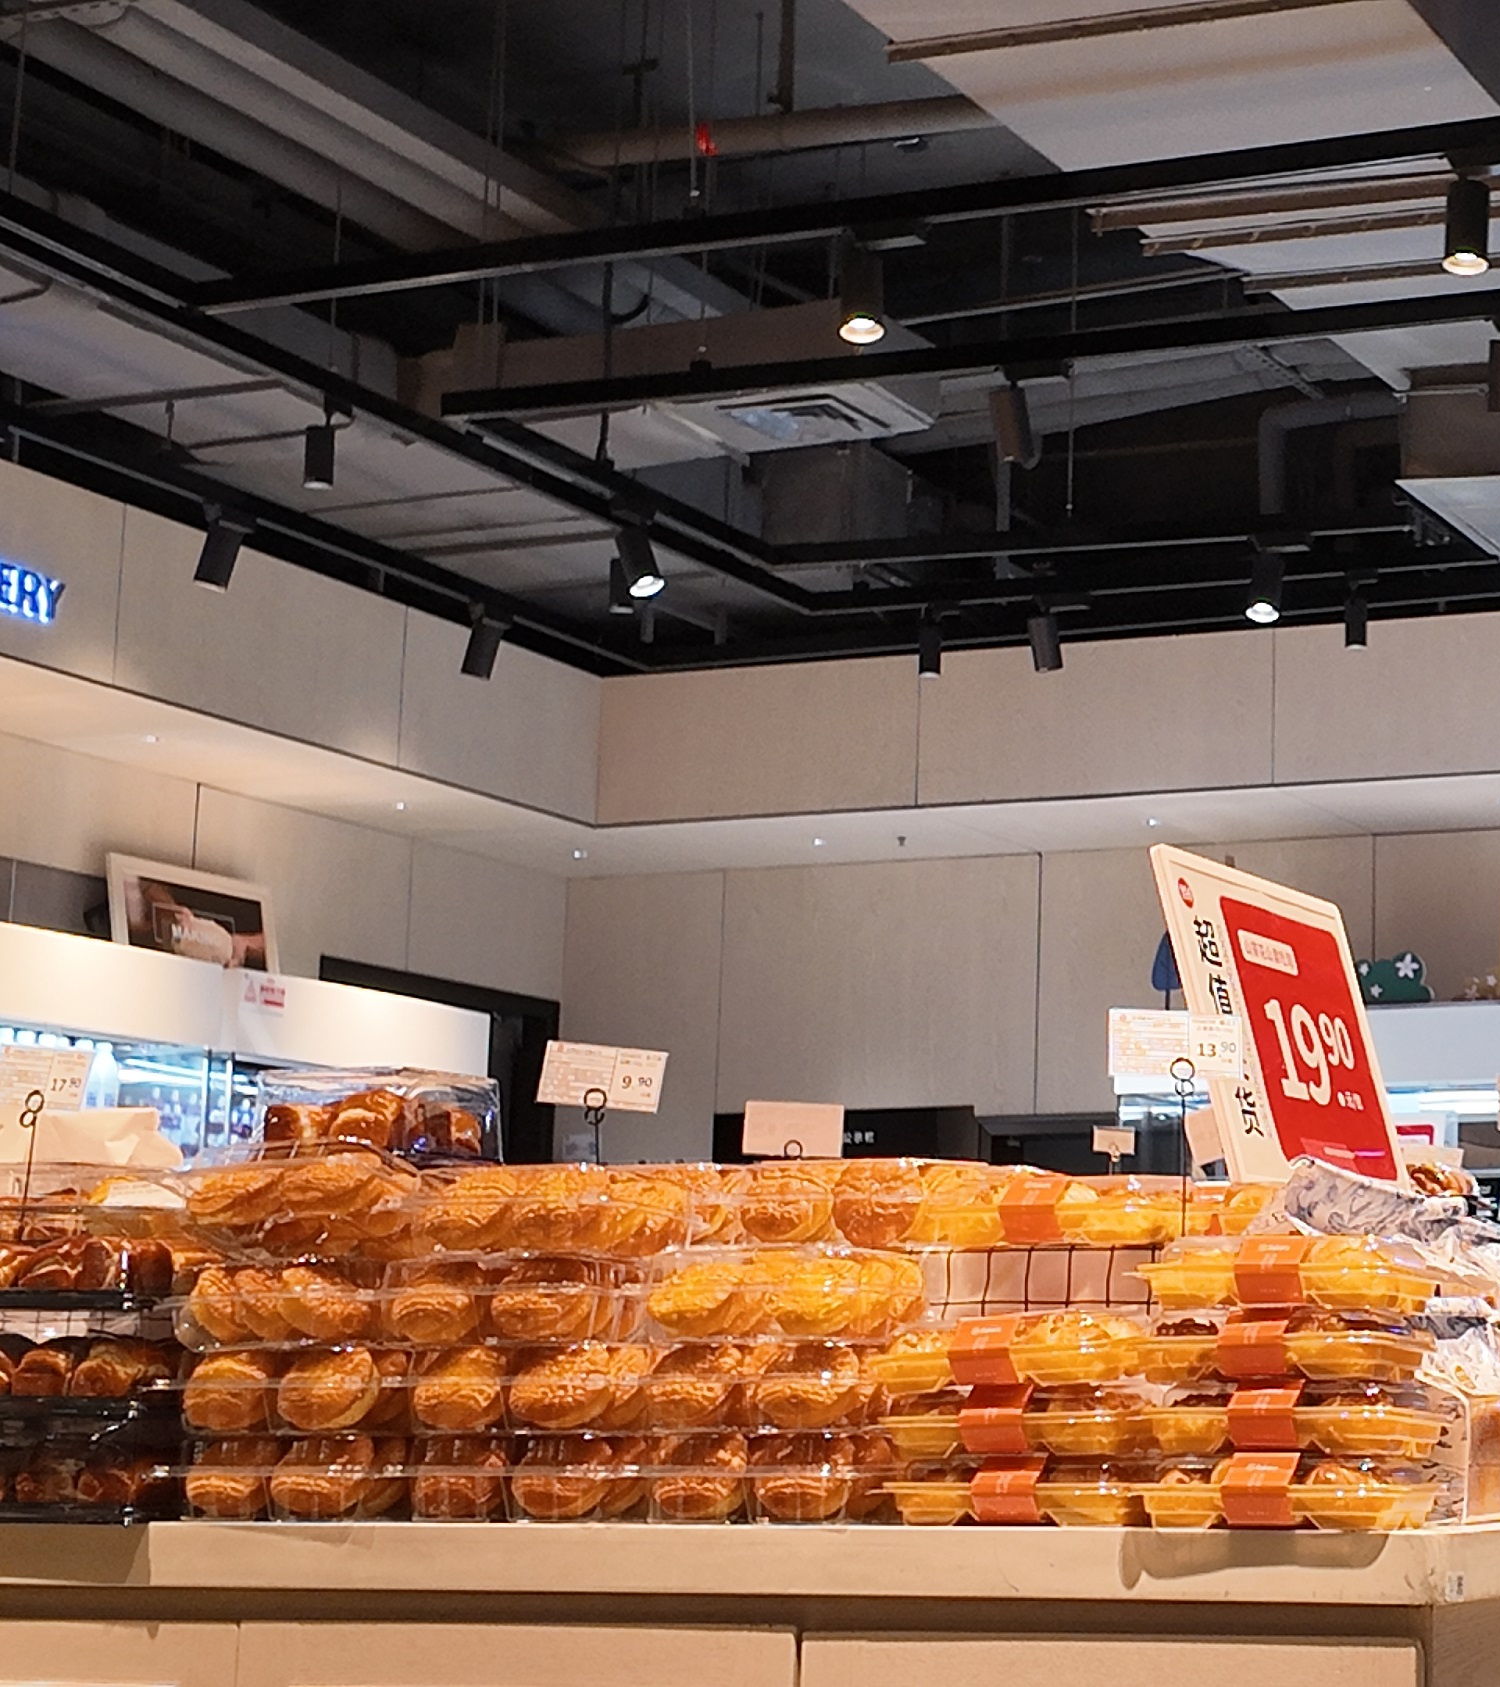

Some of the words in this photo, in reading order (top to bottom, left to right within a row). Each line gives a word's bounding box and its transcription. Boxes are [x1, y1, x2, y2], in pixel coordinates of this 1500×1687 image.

[0, 563, 66, 622] ERY
[1193, 915, 1264, 1137] 超值货
